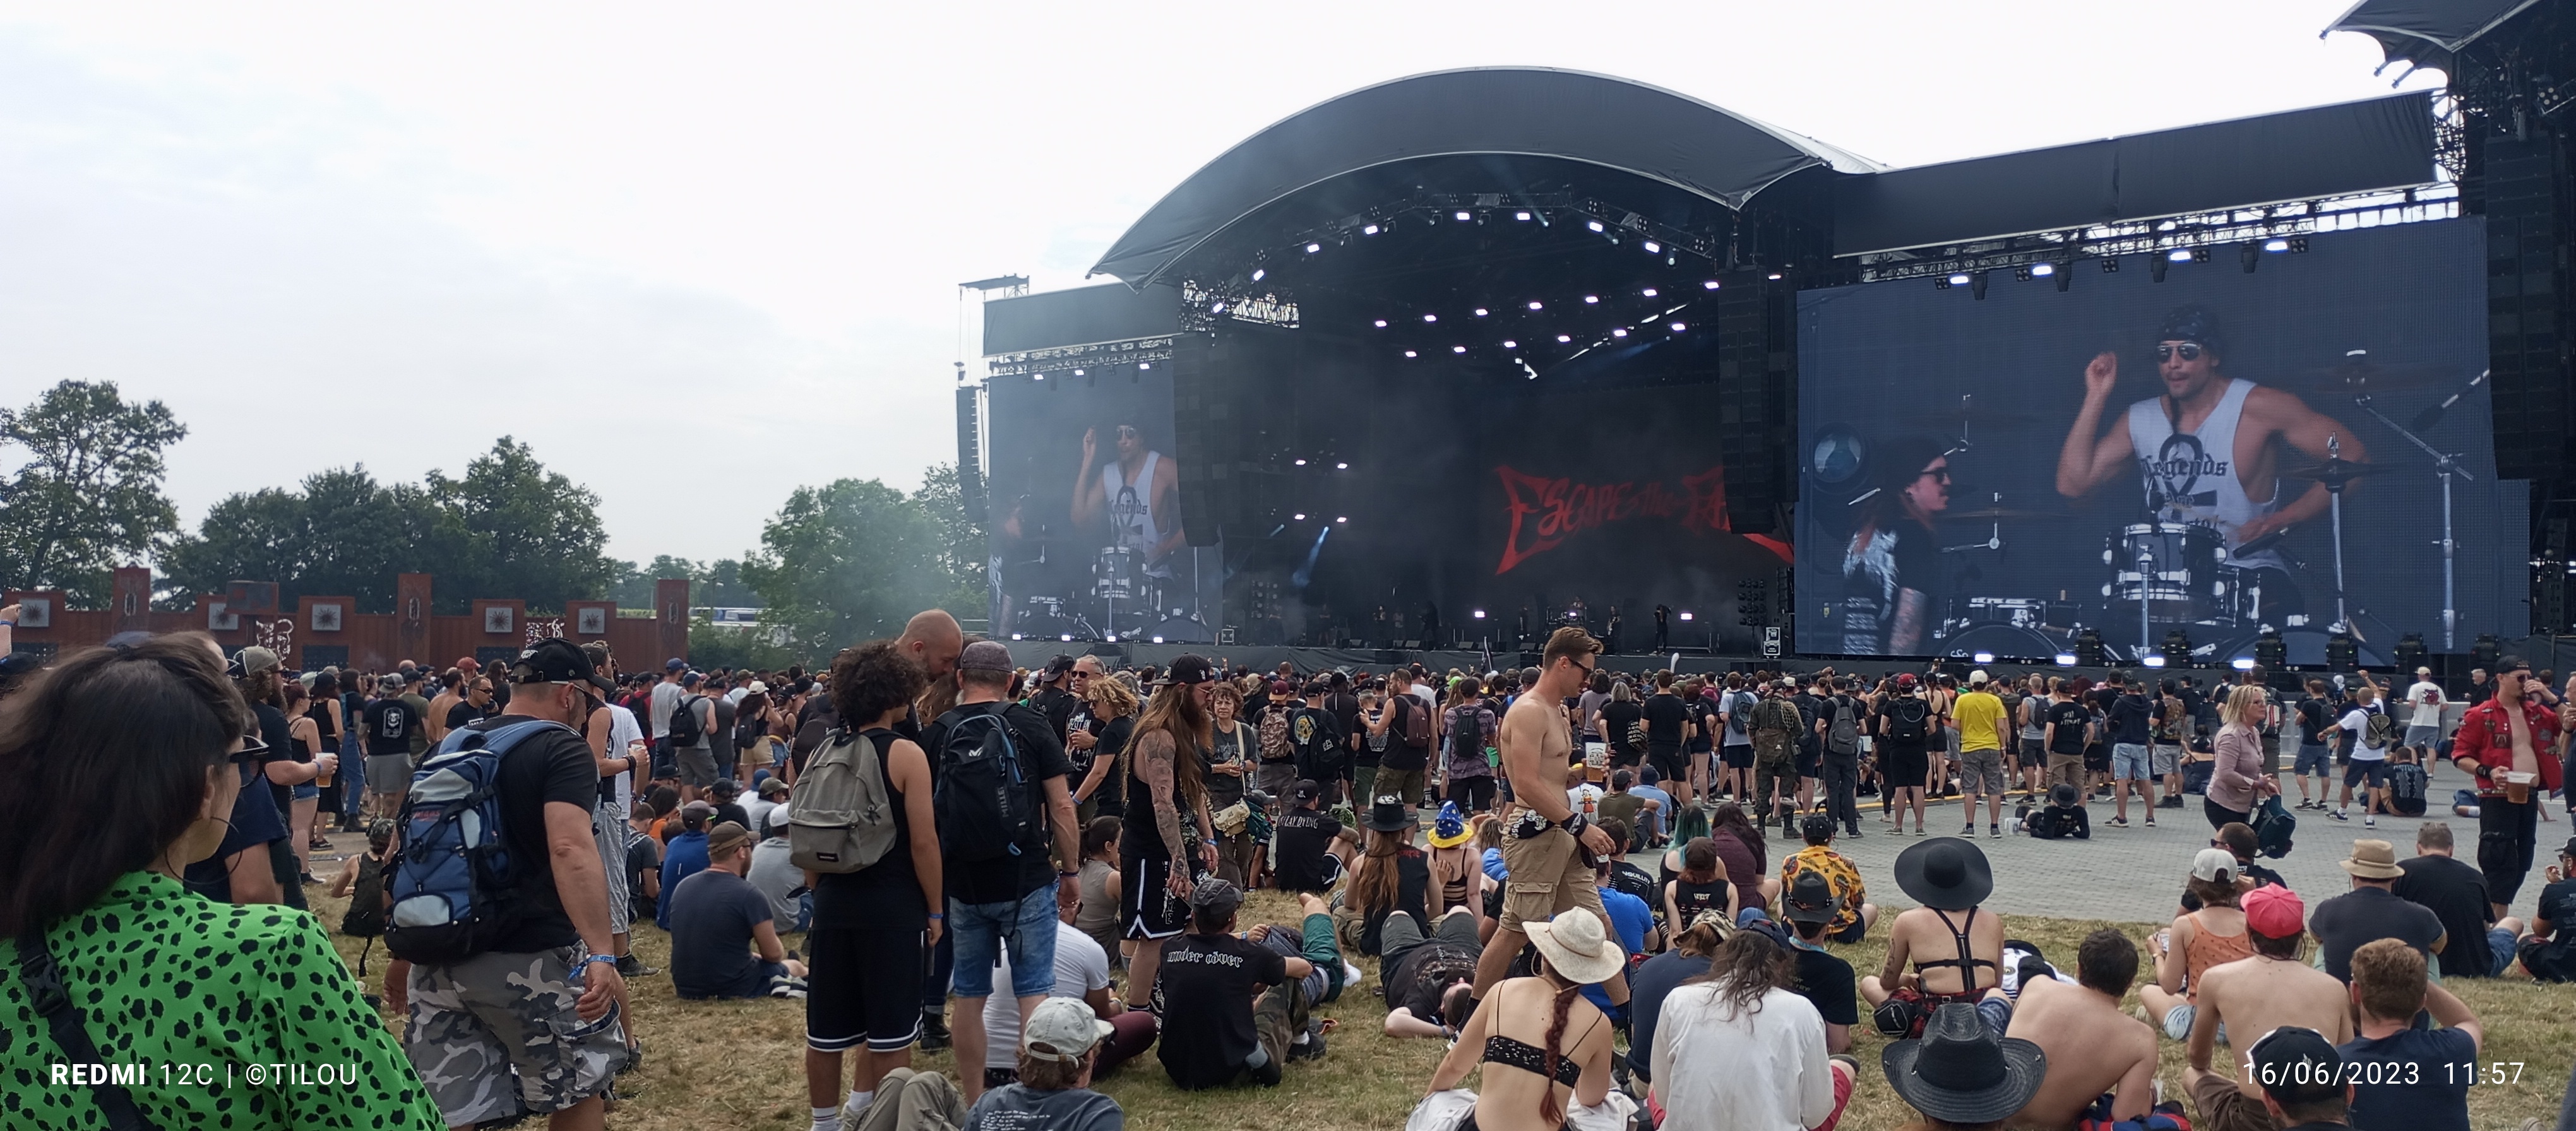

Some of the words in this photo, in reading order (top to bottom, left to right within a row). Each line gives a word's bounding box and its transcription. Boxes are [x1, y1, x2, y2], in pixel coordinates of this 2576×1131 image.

[2140, 453, 2229, 480] Legends
[1297, 815, 1319, 829] DYING
[1167, 945, 1203, 962] under
